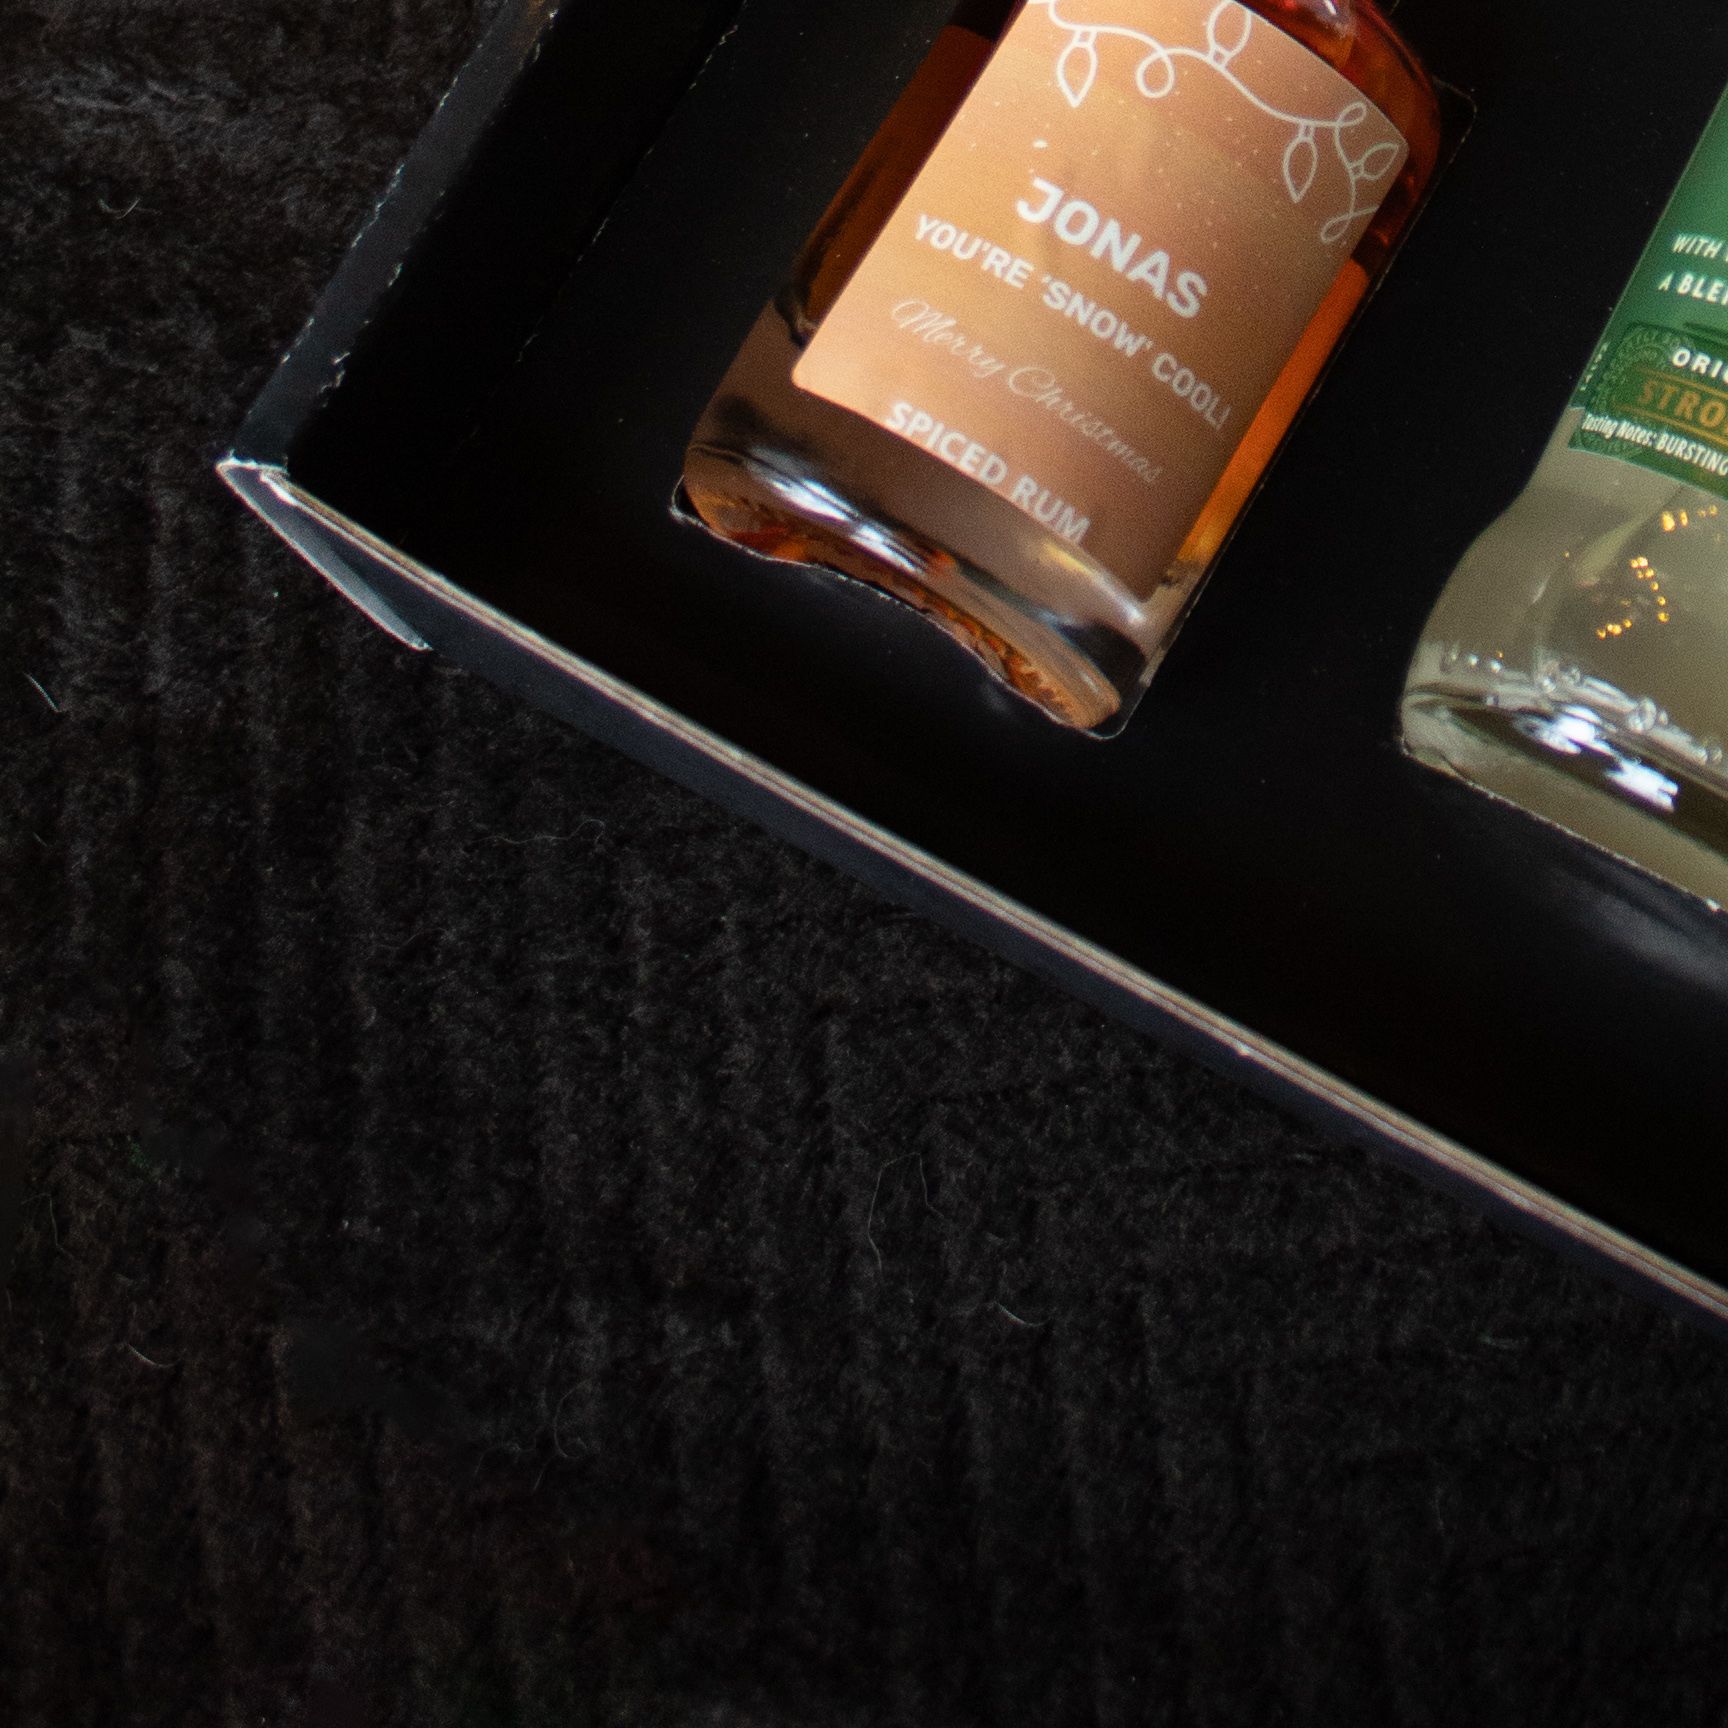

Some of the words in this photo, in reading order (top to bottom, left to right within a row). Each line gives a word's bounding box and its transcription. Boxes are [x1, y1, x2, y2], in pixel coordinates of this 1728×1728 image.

[1016, 177, 1208, 319] JONAS
[1658, 272, 1675, 290] A
[1672, 233, 1723, 258] WITH
[891, 297, 1005, 379] Merry
[1008, 364, 1161, 483] Christmas
[915, 214, 1033, 290] YOU'RE
[1153, 352, 1231, 433] COOL!
[884, 401, 1007, 487] SPICED
[1012, 475, 1092, 545] RUM
